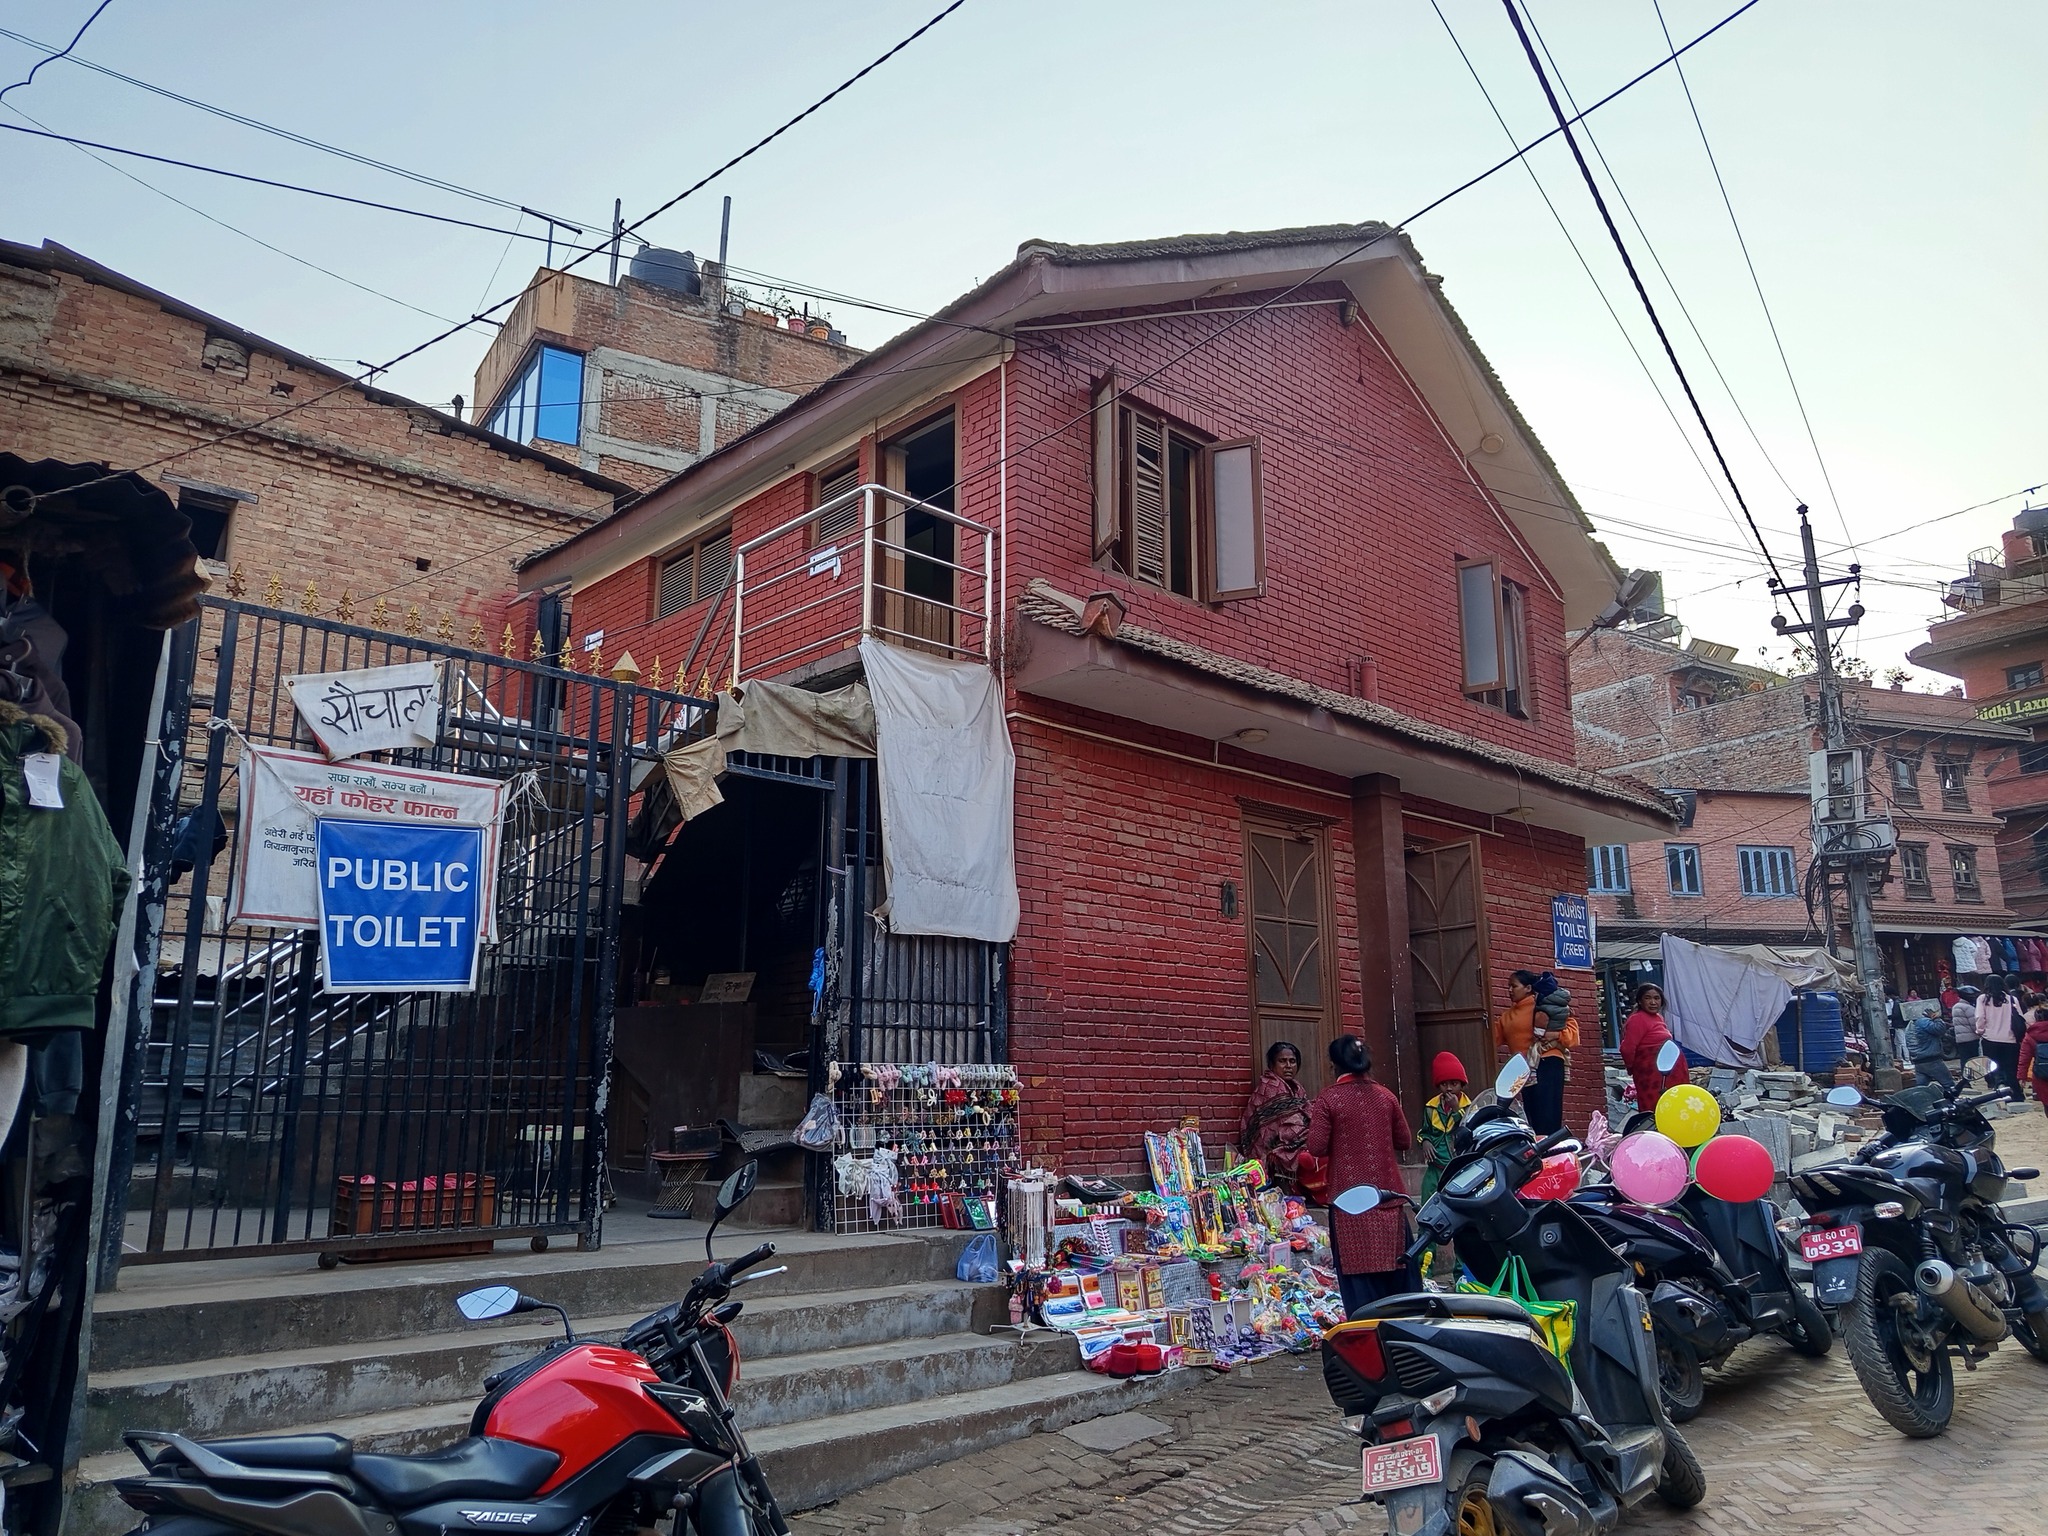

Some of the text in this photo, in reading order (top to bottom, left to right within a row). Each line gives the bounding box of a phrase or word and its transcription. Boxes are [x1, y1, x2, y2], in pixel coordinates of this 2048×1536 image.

[321, 680, 434, 736] सौचाल
[328, 772, 349, 784] सफा
[382, 780, 406, 793] सभ्य
[294, 785, 334, 805] यहाँ
[328, 857, 469, 893] PUBLIC
[1554, 901, 1586, 920] TOURIST
[329, 914, 466, 948] TOILET
[1557, 921, 1588, 940] TOILET
[1562, 942, 1586, 960] (FREE)
[1825, 1231, 1837, 1241] ६०
[1839, 1229, 1847, 1238] प
[1805, 1238, 1859, 1258] ७२३१
[460, 1510, 538, 1525] RAIDER
